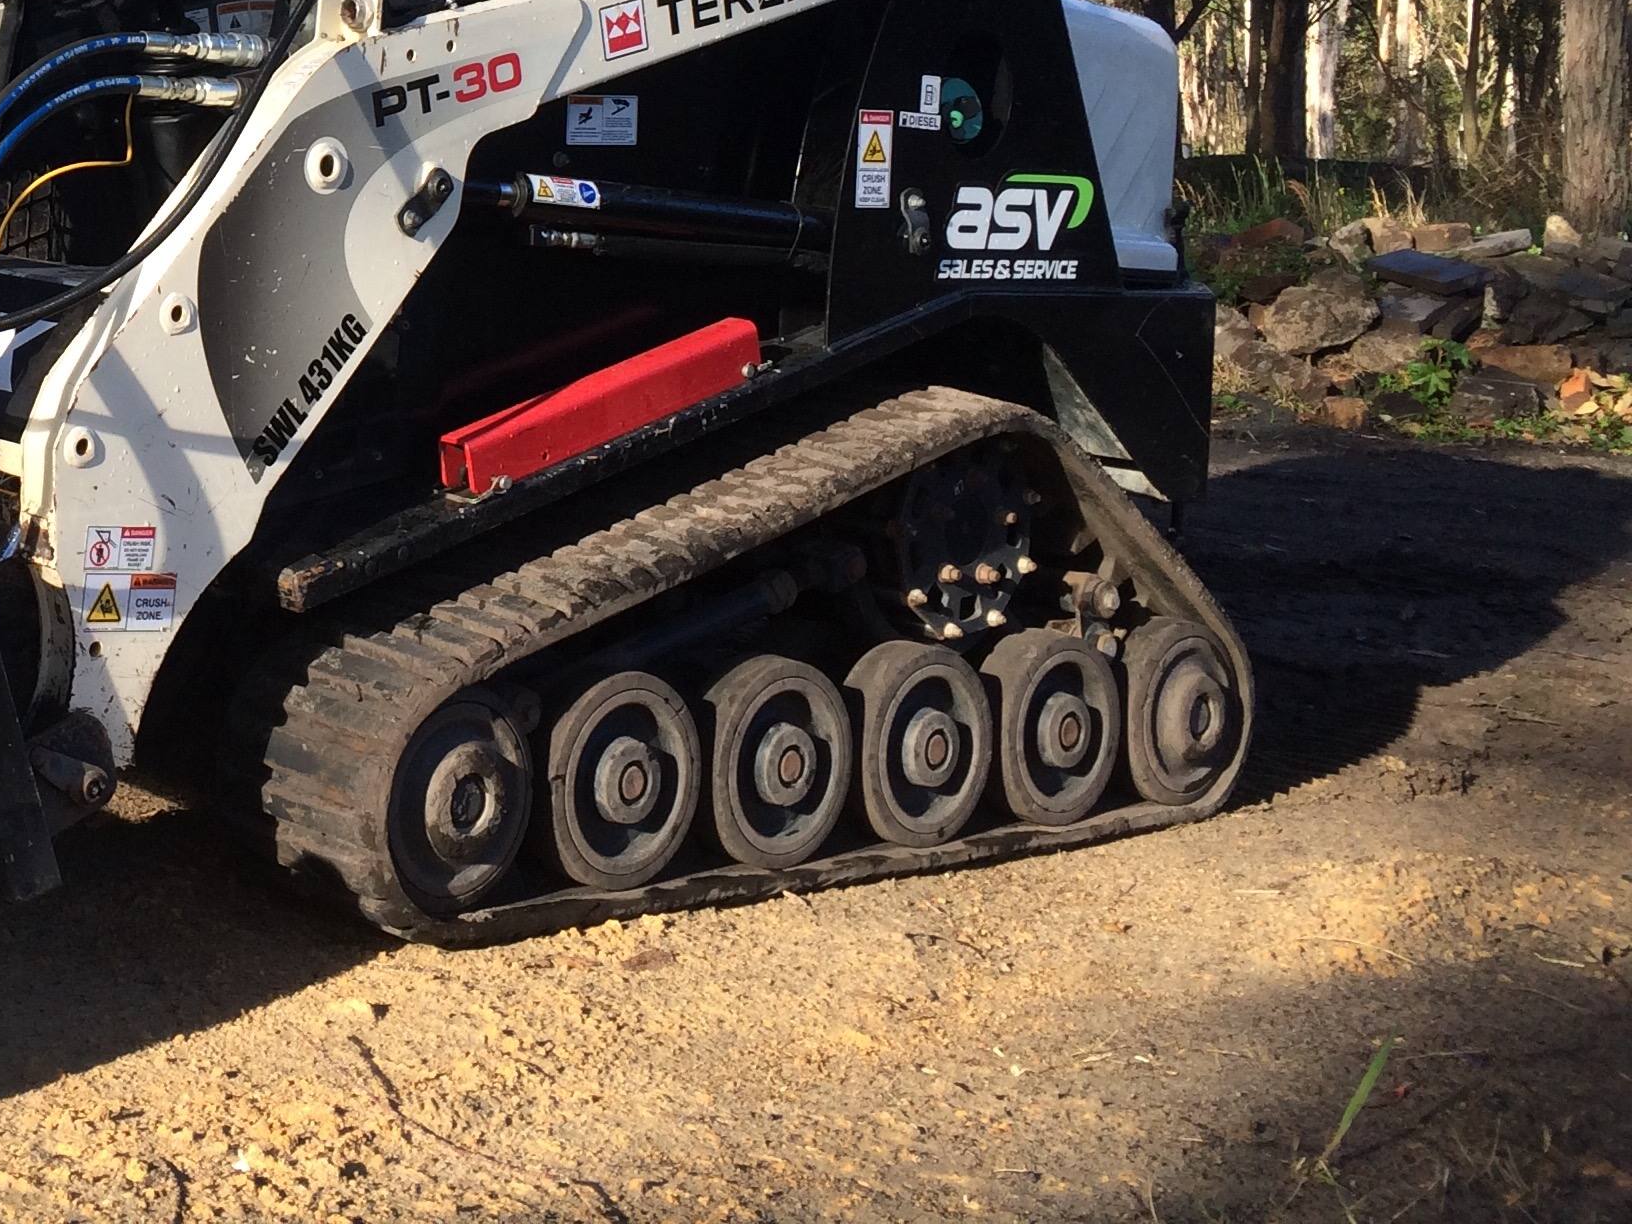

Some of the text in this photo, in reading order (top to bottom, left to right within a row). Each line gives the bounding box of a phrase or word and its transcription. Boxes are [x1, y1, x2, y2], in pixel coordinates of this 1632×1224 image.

[372, 52, 522, 128] PT-30
[909, 115, 939, 128] DIESEL
[861, 174, 886, 183] CRUSH
[863, 186, 882, 195] ZONE
[994, 260, 1011, 280] &
[1013, 260, 1079, 280] SERVICE
[253, 313, 367, 467] SWL 431KG
[135, 598, 168, 609] CRUSH
